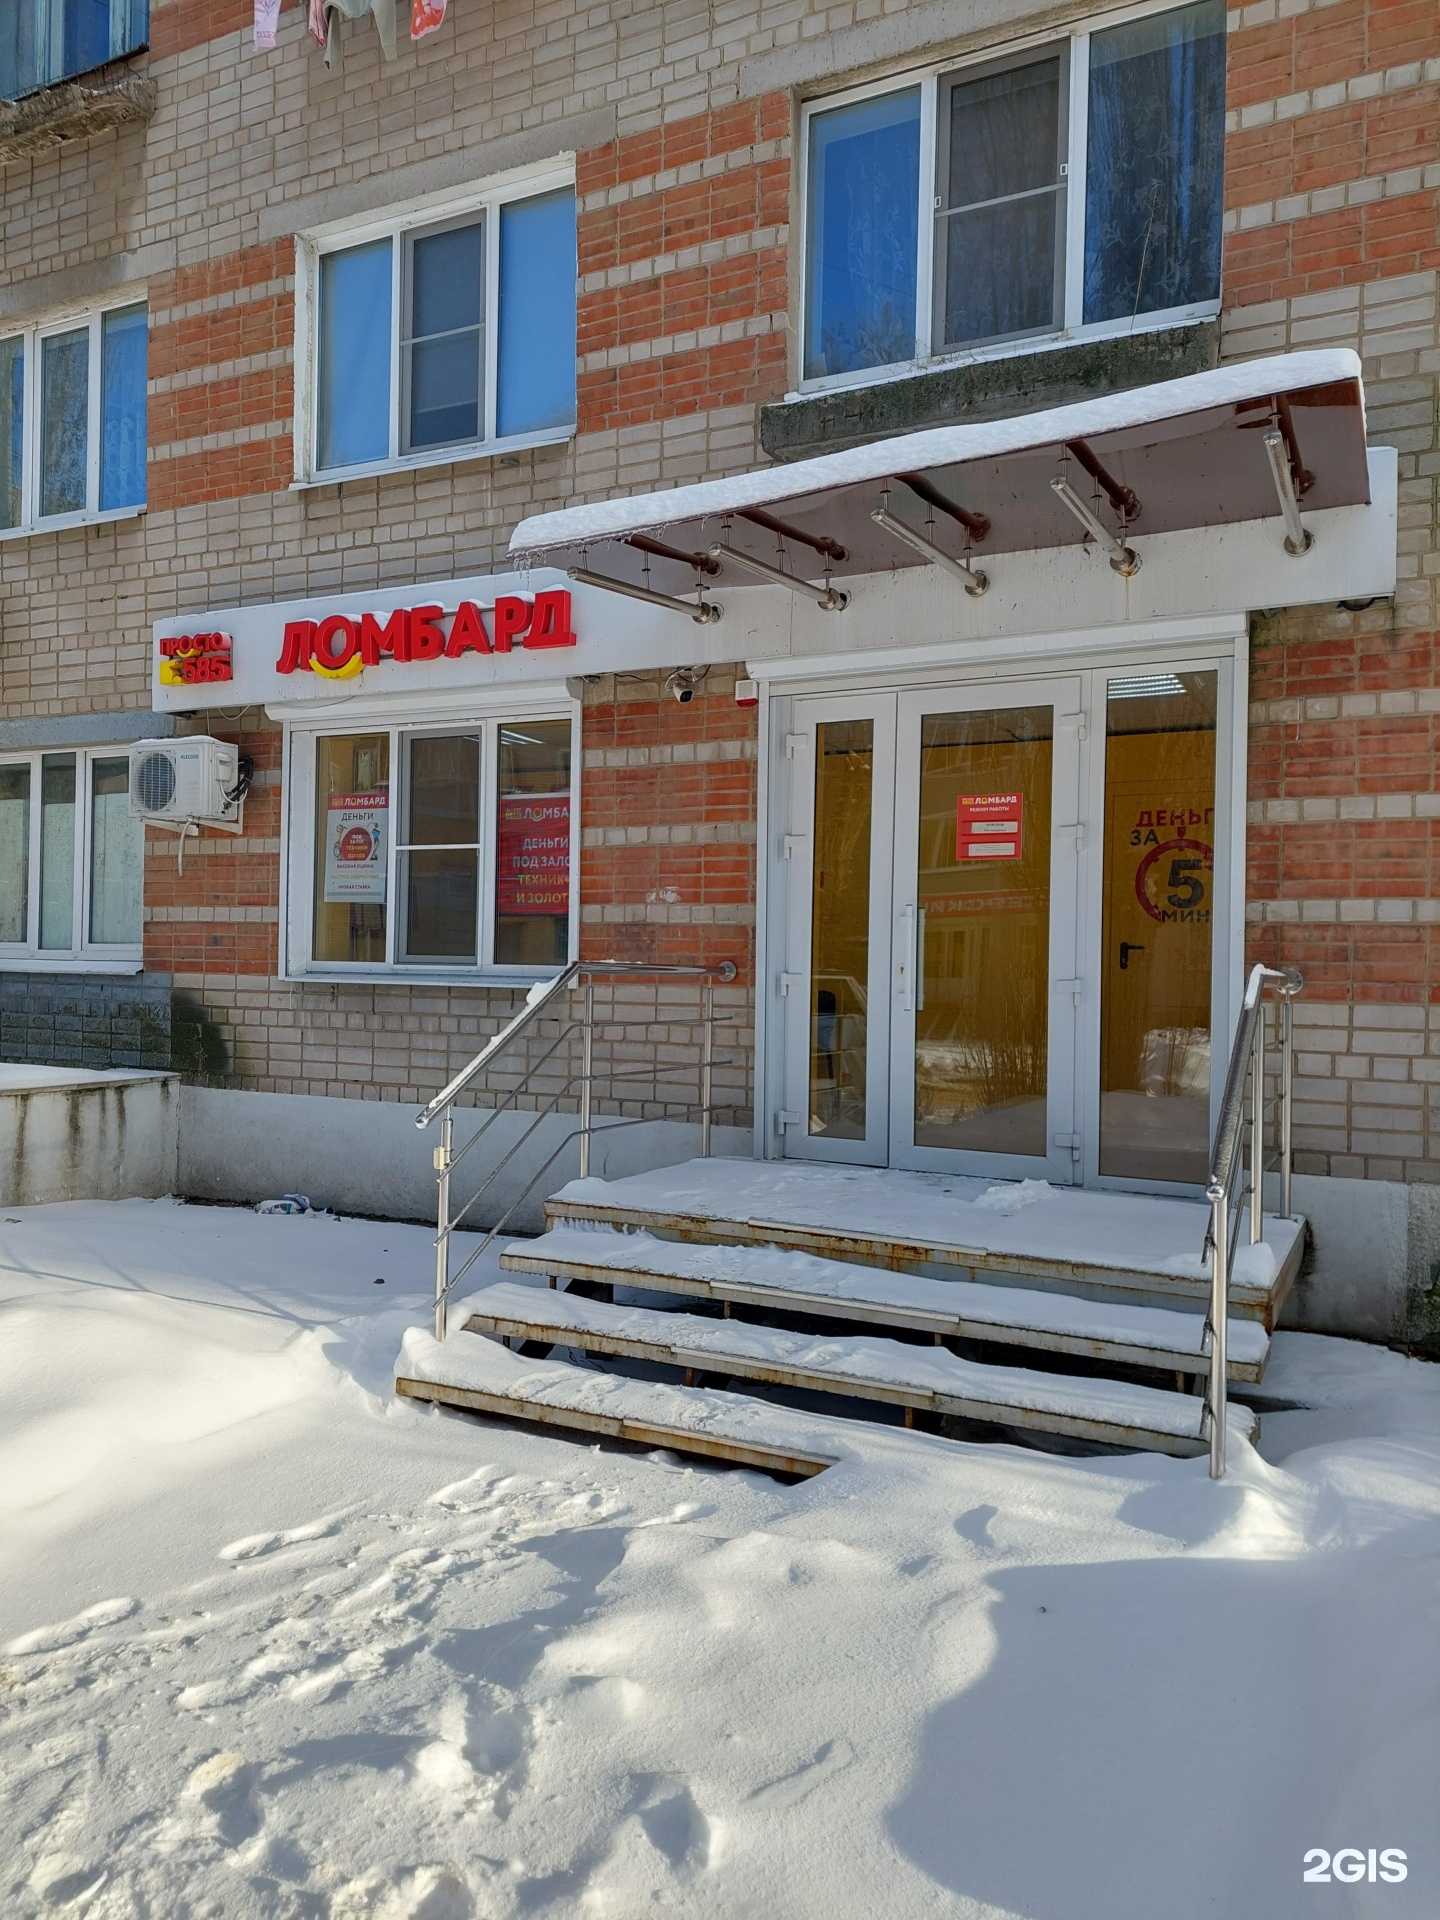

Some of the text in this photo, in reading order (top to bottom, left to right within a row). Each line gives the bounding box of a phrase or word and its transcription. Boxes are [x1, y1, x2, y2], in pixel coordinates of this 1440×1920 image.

[276, 590, 576, 674] ЛОМБАРД
[160, 632, 231, 656] ПРОСТО
[183, 657, 231, 684] 585
[344, 797, 385, 806] ЛОМБАРД
[975, 796, 1017, 805] ЛОМБАРД
[341, 812, 374, 821] ДЕНЬГИ
[523, 837, 569, 850] ДЕНЬГИ
[1130, 829, 1159, 846] ЗА
[512, 855, 538, 868] ПОД
[1168, 859, 1205, 909] 5
[516, 892, 568, 903] И ЗОЛОТ
